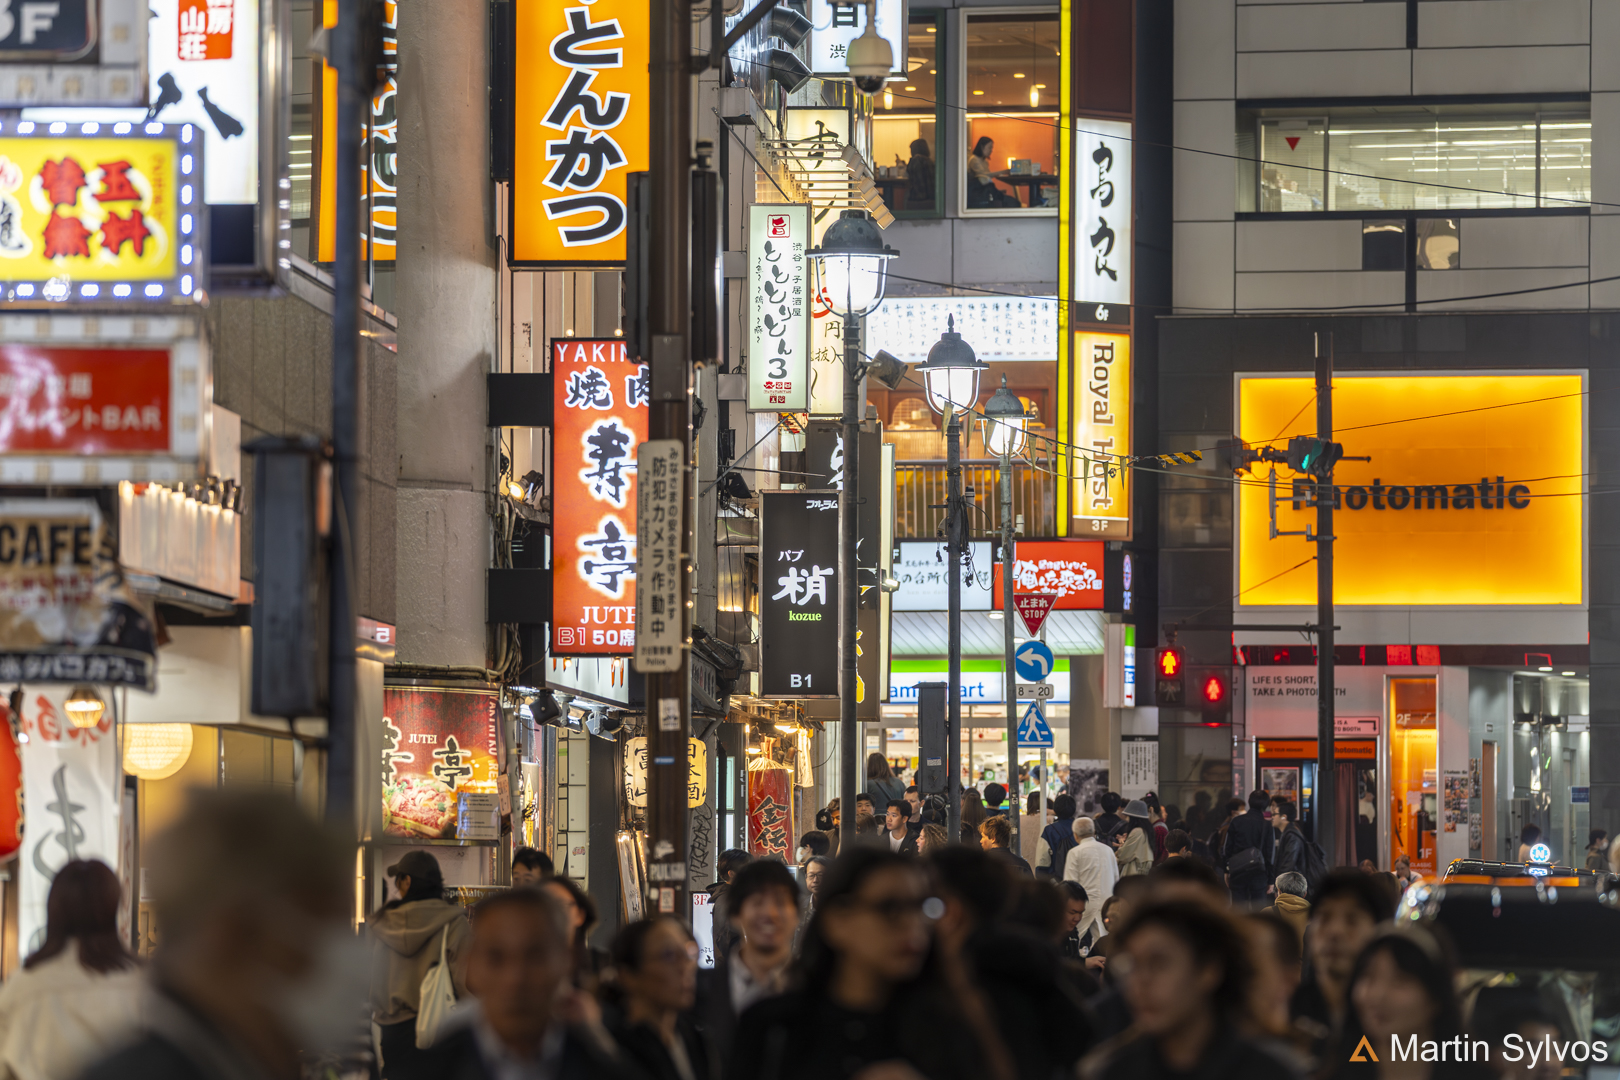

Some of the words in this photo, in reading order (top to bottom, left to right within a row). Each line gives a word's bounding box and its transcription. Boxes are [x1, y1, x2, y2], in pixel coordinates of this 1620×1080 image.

[541, 7, 631, 246] とんかつ
[1095, 304, 1109, 321] 6F
[1089, 342, 1114, 425] Royal
[1092, 437, 1114, 510] Host
[1292, 475, 1531, 510] Potomatic
[1092, 520, 1108, 531] 3F
[0, 523, 92, 564] CAFE
[651, 457, 668, 639] 防犯カメラ作動中
[778, 550, 804, 562] パブ
[772, 565, 834, 606] 梢
[1019, 597, 1049, 608] 止まれ
[788, 610, 822, 622] kozue
[1024, 610, 1045, 618] STOP
[557, 627, 586, 646] B1
[790, 674, 812, 688] B1
[1252, 676, 1271, 684] LIFE
[1273, 676, 1282, 684] IS
[1285, 676, 1317, 685] SHORT,
[1038, 687, 1050, 696] 20
[1253, 688, 1275, 696] TAKE
[1278, 688, 1284, 696] A
[1286, 688, 1346, 696] PHOTOTH
[1396, 714, 1411, 724] 2F
[408, 733, 438, 745] JUTEI
